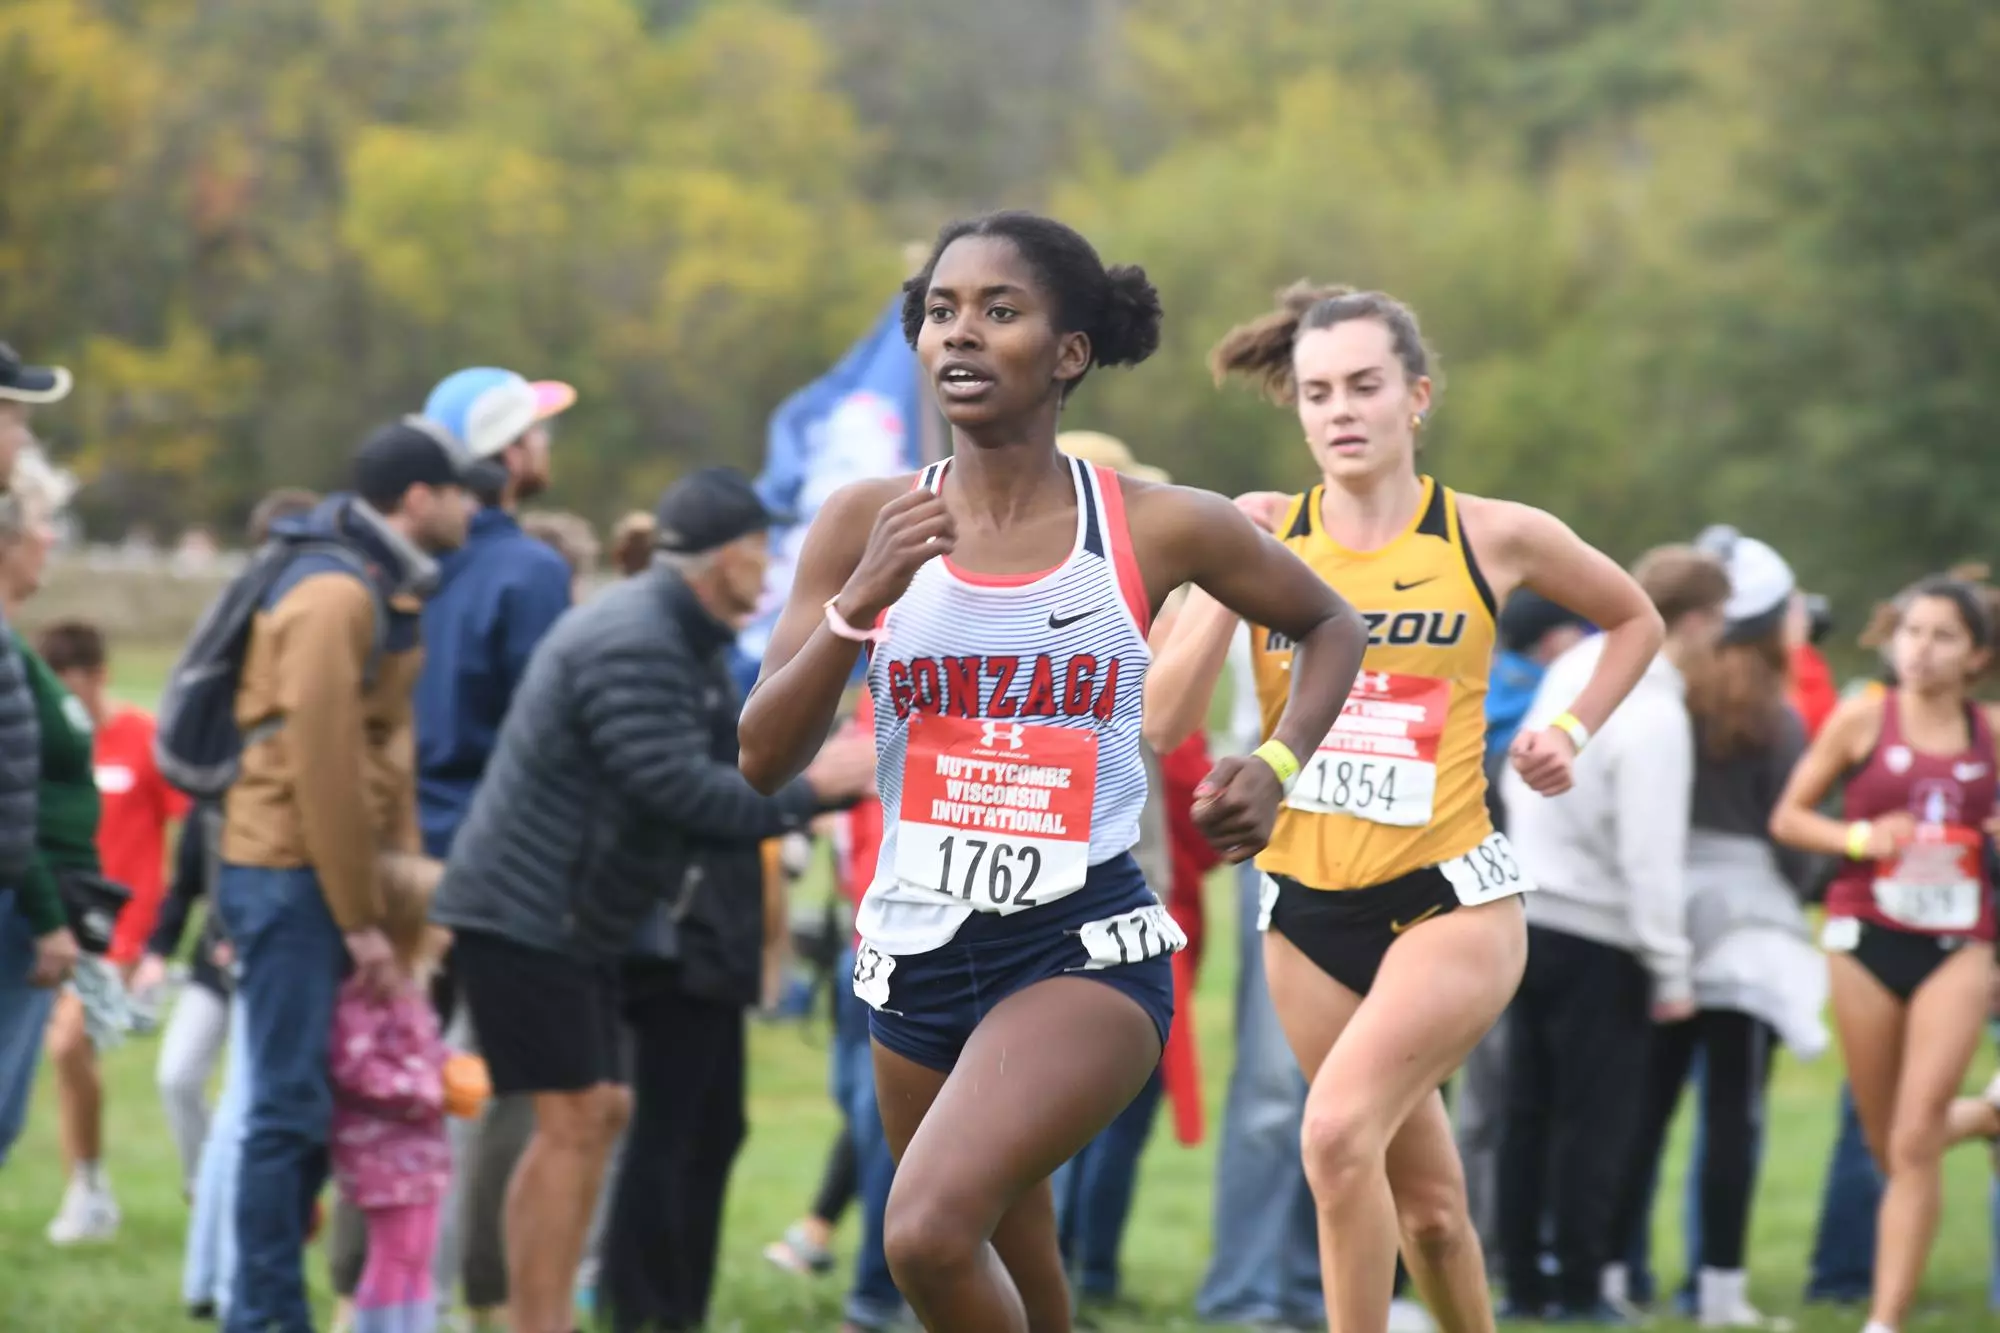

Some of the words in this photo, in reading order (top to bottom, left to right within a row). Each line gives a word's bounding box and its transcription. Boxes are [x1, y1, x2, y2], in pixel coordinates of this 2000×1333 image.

[888, 654, 1119, 721] GONZAGA
[936, 754, 1072, 788] NUTTYCOMBE
[946, 779, 1051, 810] WISCONSIN
[1317, 759, 1396, 811] 1854
[931, 799, 1066, 834] INVITATIONAL
[934, 835, 1041, 906] 1762
[1463, 839, 1519, 891] 185
